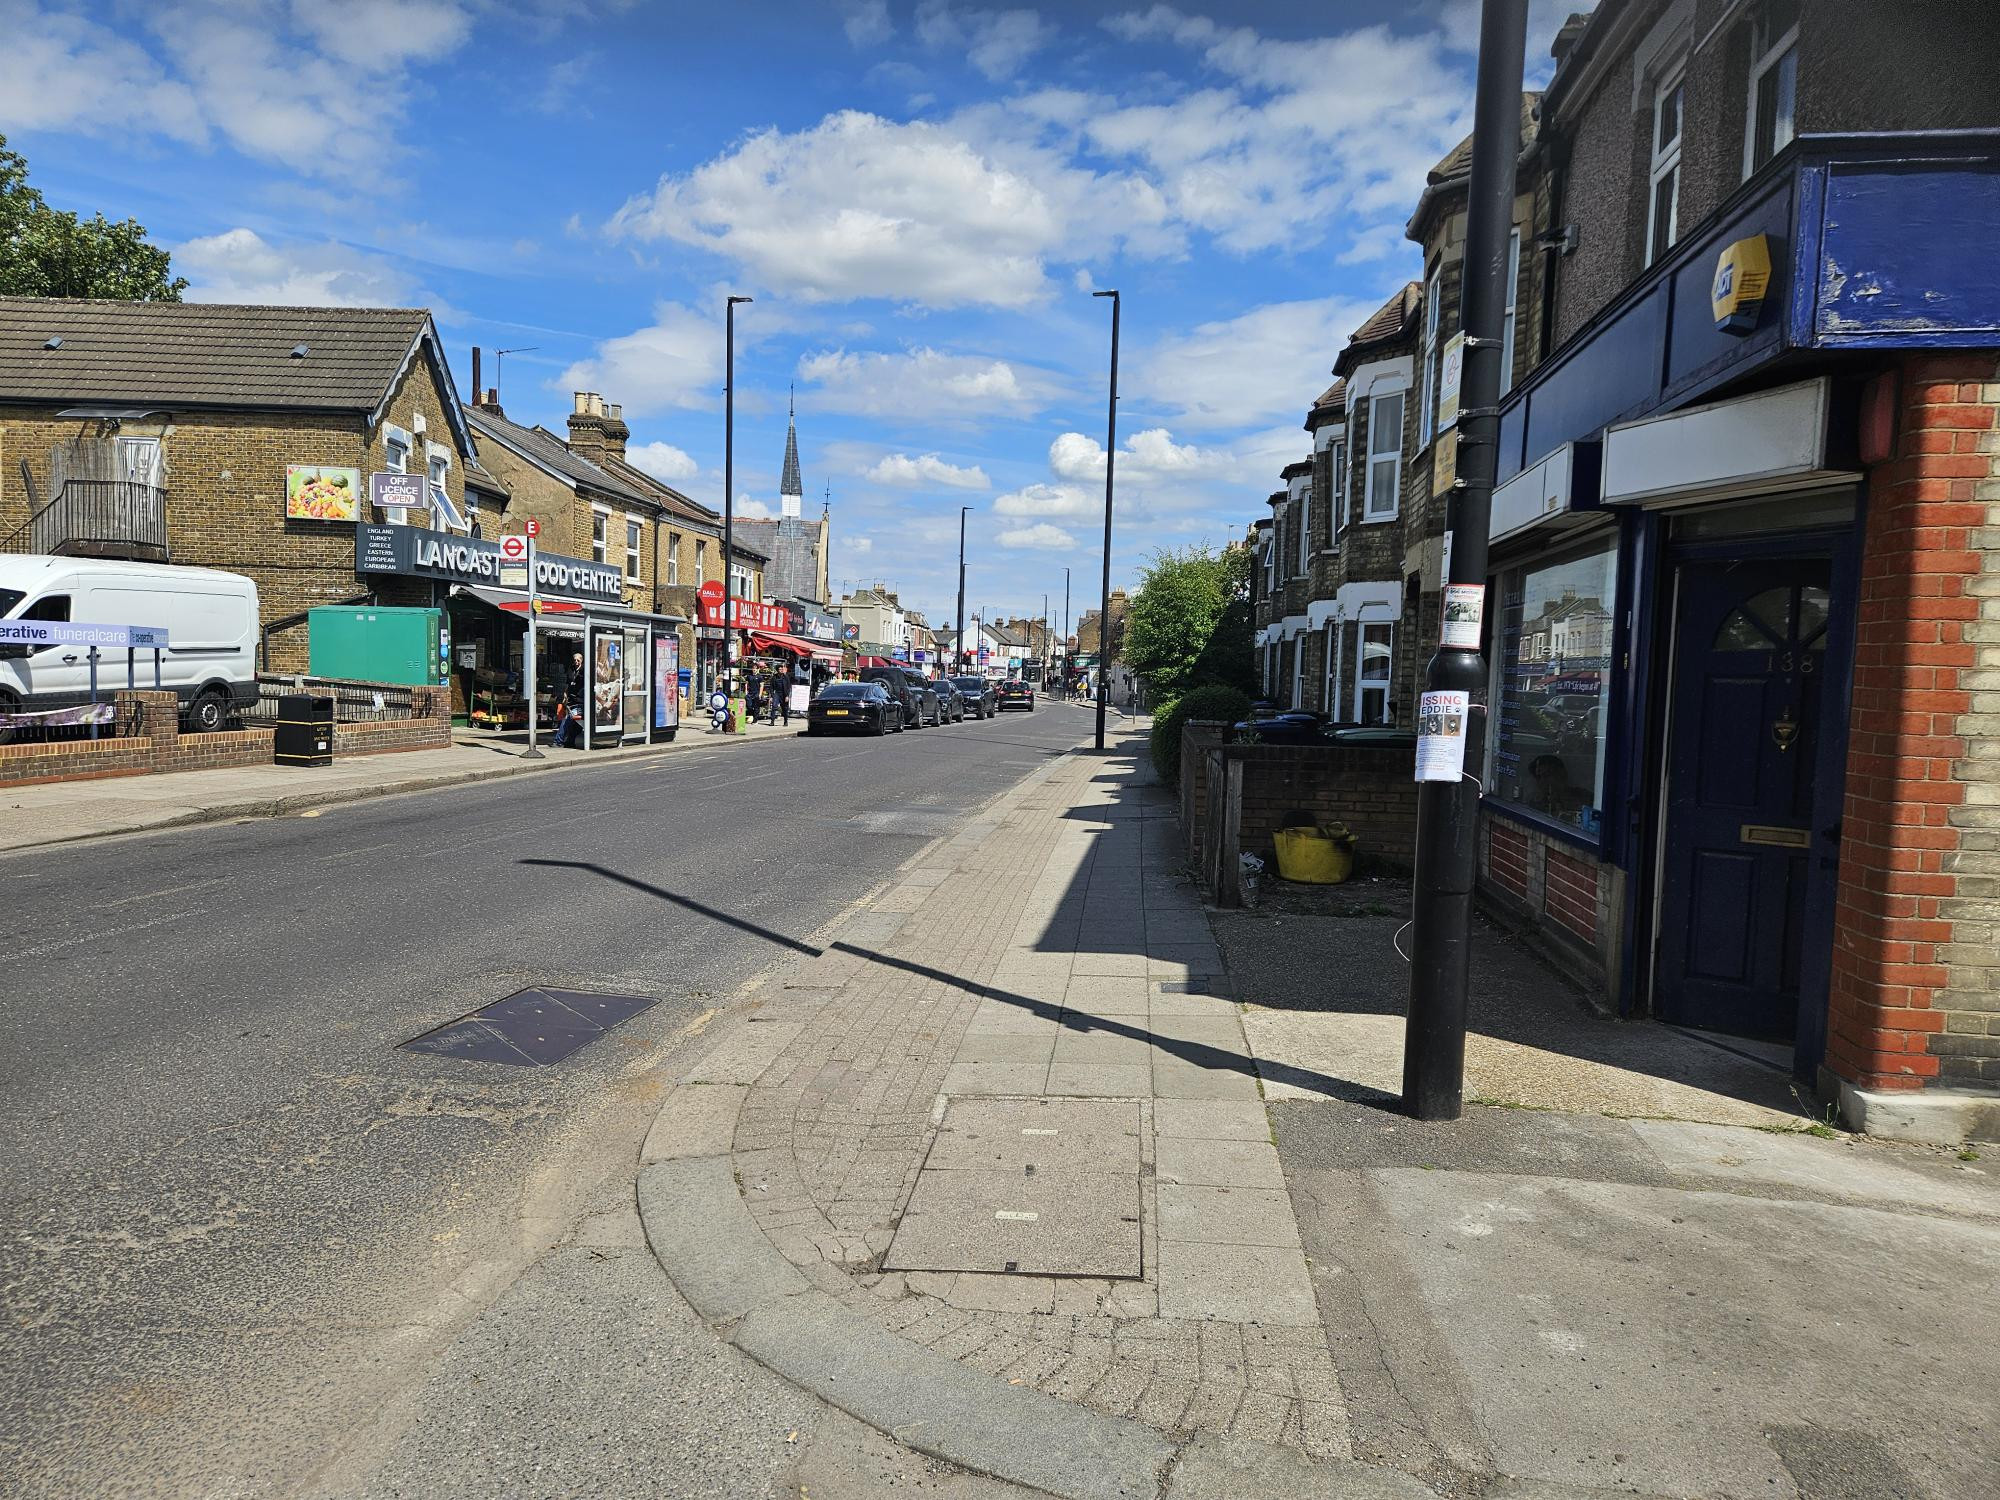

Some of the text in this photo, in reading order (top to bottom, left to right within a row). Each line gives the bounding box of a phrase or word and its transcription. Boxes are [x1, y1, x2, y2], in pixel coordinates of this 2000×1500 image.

[390, 477, 408, 485] OFF
[380, 485, 418, 495] LICENCE
[387, 494, 411, 502] OPEN
[528, 521, 536, 533] E
[417, 539, 500, 576] LANCAST
[535, 560, 568, 585] OOD
[572, 567, 621, 594] CENTRE
[54, 626, 127, 642] funeralcare
[1422, 695, 1462, 706] ISSING
[1421, 705, 1452, 714] EDDIE
